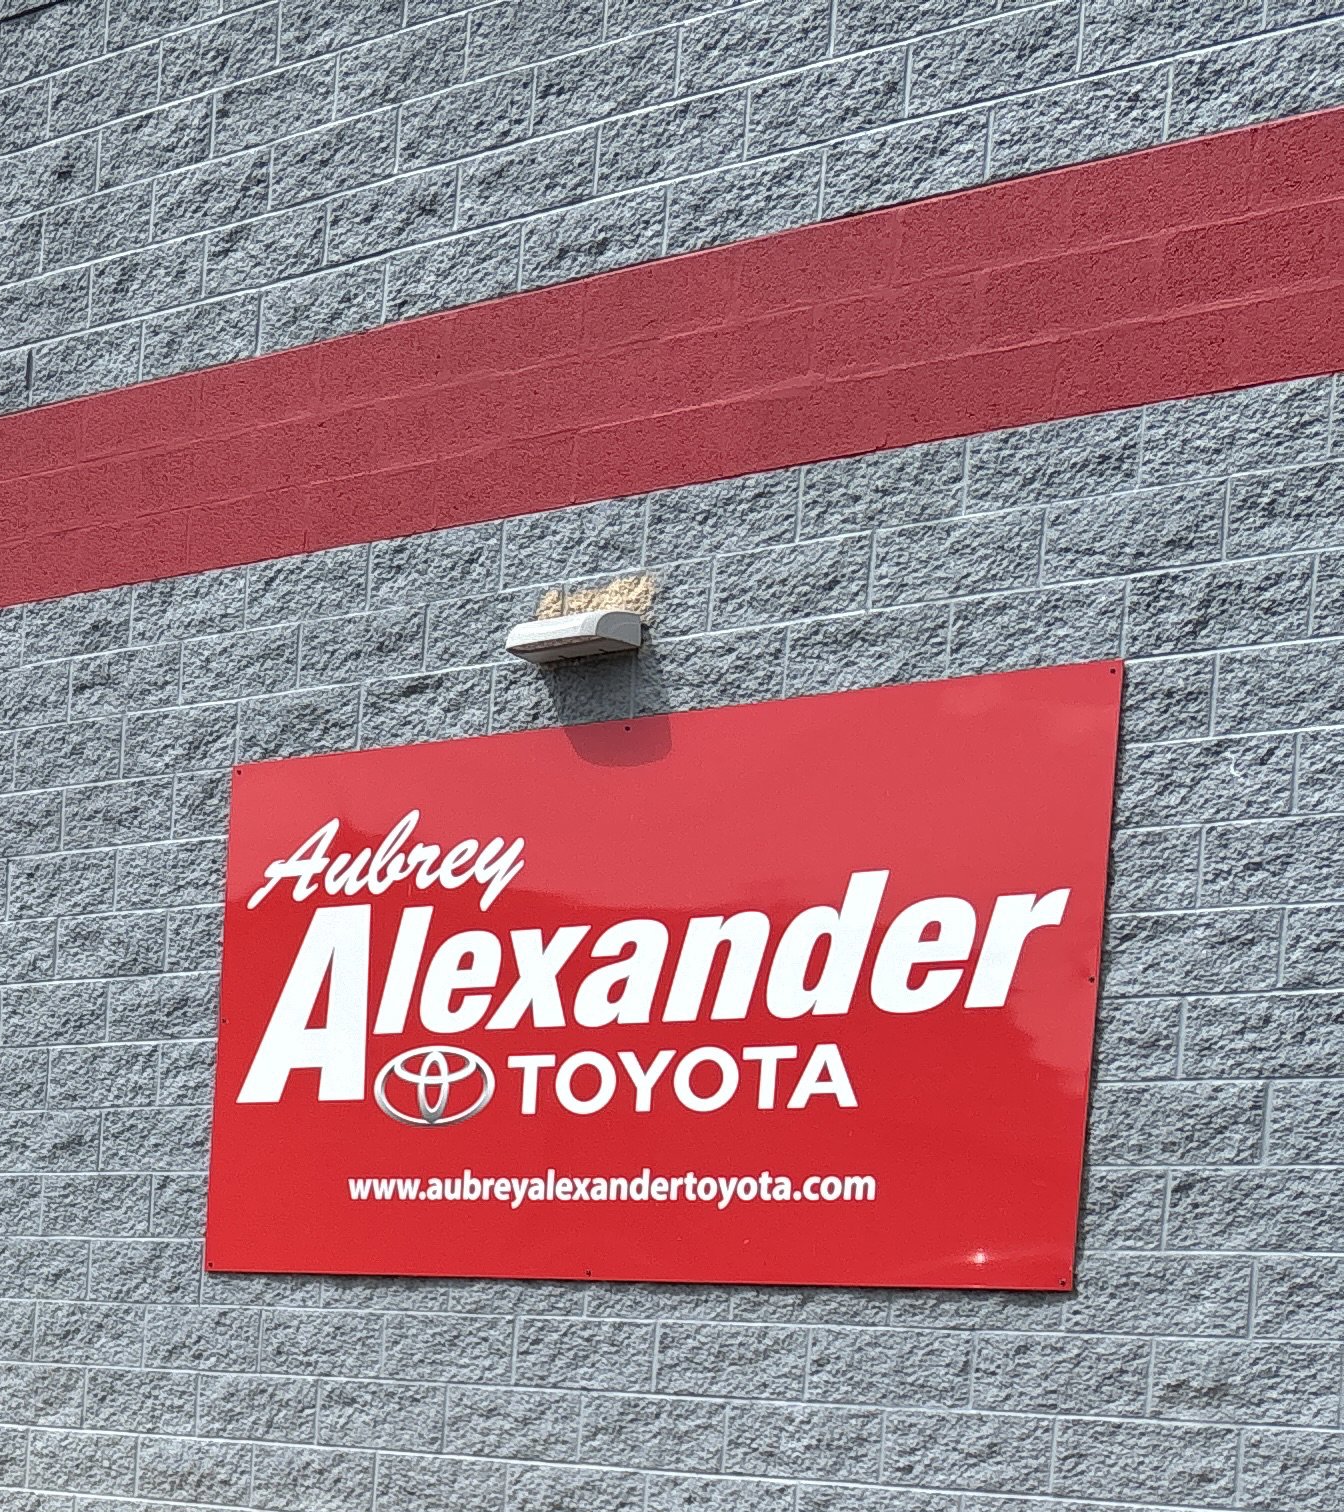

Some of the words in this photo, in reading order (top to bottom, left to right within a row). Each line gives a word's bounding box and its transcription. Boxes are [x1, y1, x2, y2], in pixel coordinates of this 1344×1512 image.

[247, 810, 524, 911] Aubrey
[237, 870, 1070, 1103] Alexander
[508, 1044, 857, 1114] TOYOTA
[349, 1169, 875, 1209] www.aubreyalexandertoyota.com
